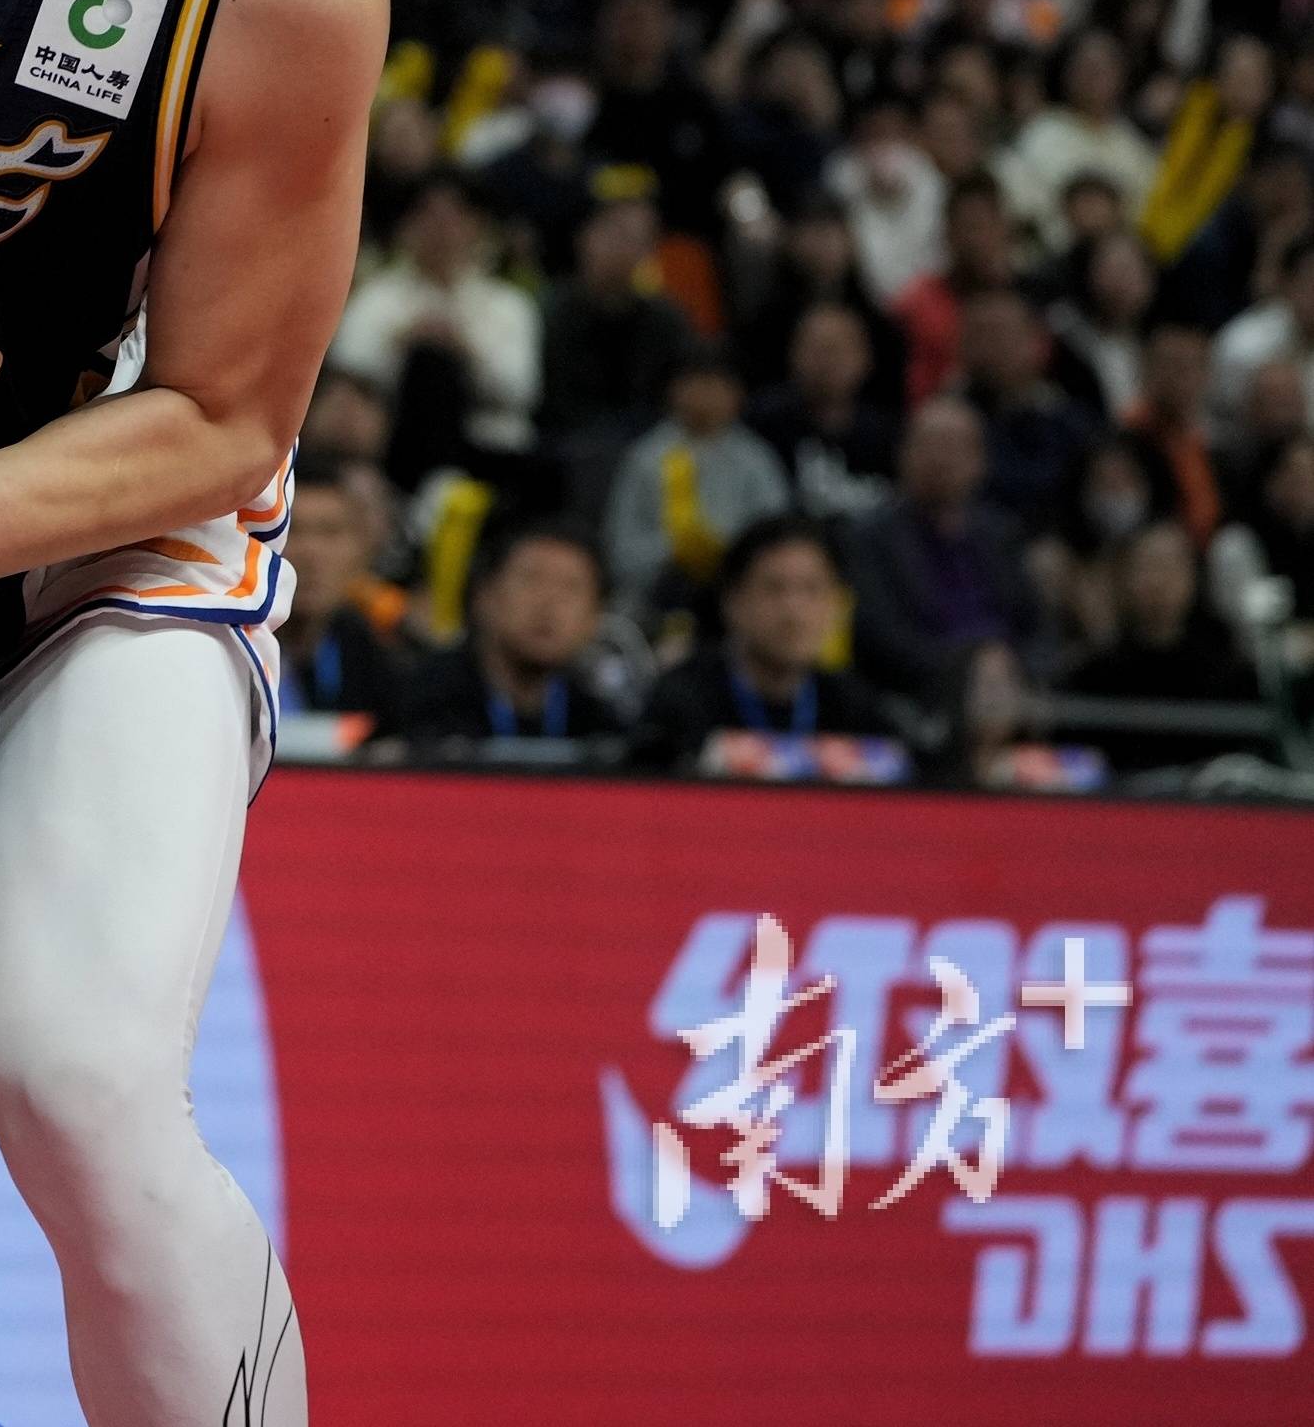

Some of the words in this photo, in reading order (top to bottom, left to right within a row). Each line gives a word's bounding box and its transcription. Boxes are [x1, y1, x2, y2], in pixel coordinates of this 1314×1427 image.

[29, 66, 81, 92] CHINA
[86, 84, 123, 105] LIFE
[942, 1196, 1314, 1358] DHS
